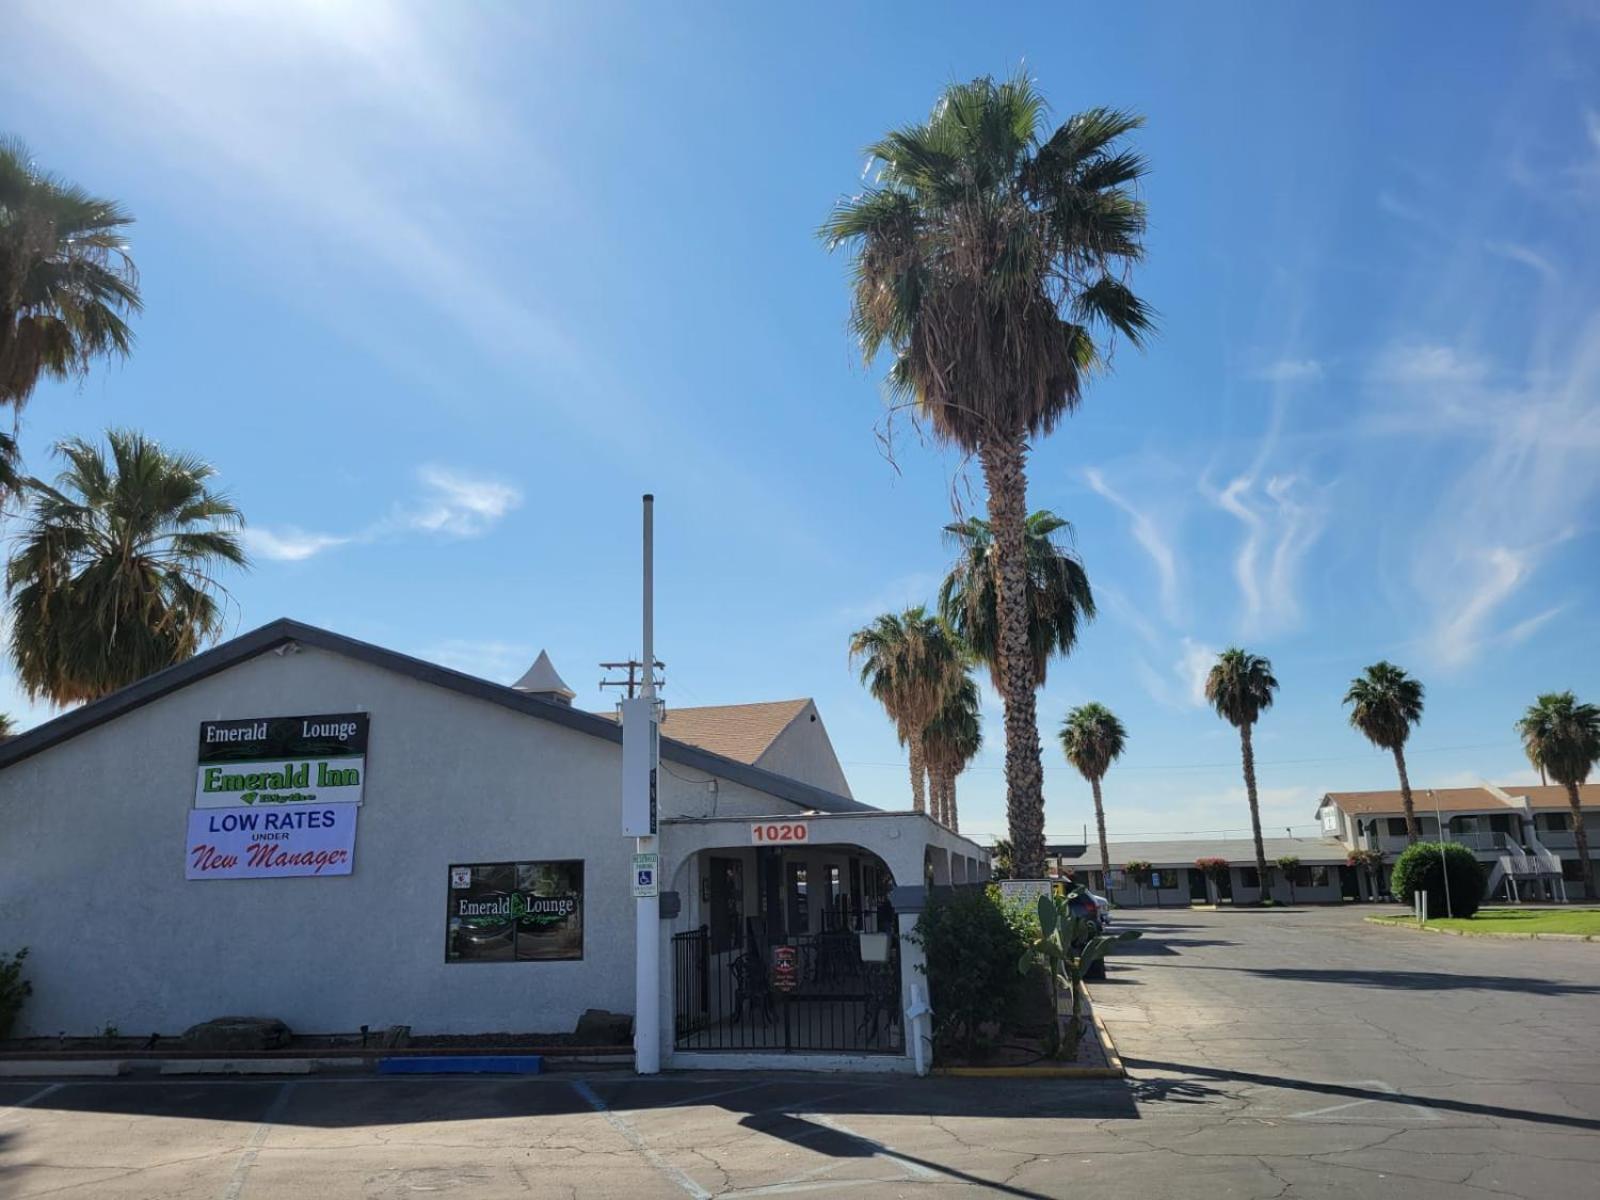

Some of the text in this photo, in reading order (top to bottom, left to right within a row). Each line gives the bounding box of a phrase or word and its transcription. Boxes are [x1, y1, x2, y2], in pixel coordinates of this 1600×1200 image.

[206, 720, 357, 743] Emerald Lounge
[203, 762, 360, 793] Emerald Inn
[209, 810, 336, 833] LOW RATES
[753, 825, 806, 841] 1020
[252, 833, 290, 842] UNDER
[191, 843, 348, 873] New Manager
[459, 897, 574, 915] Emerald Lounge
